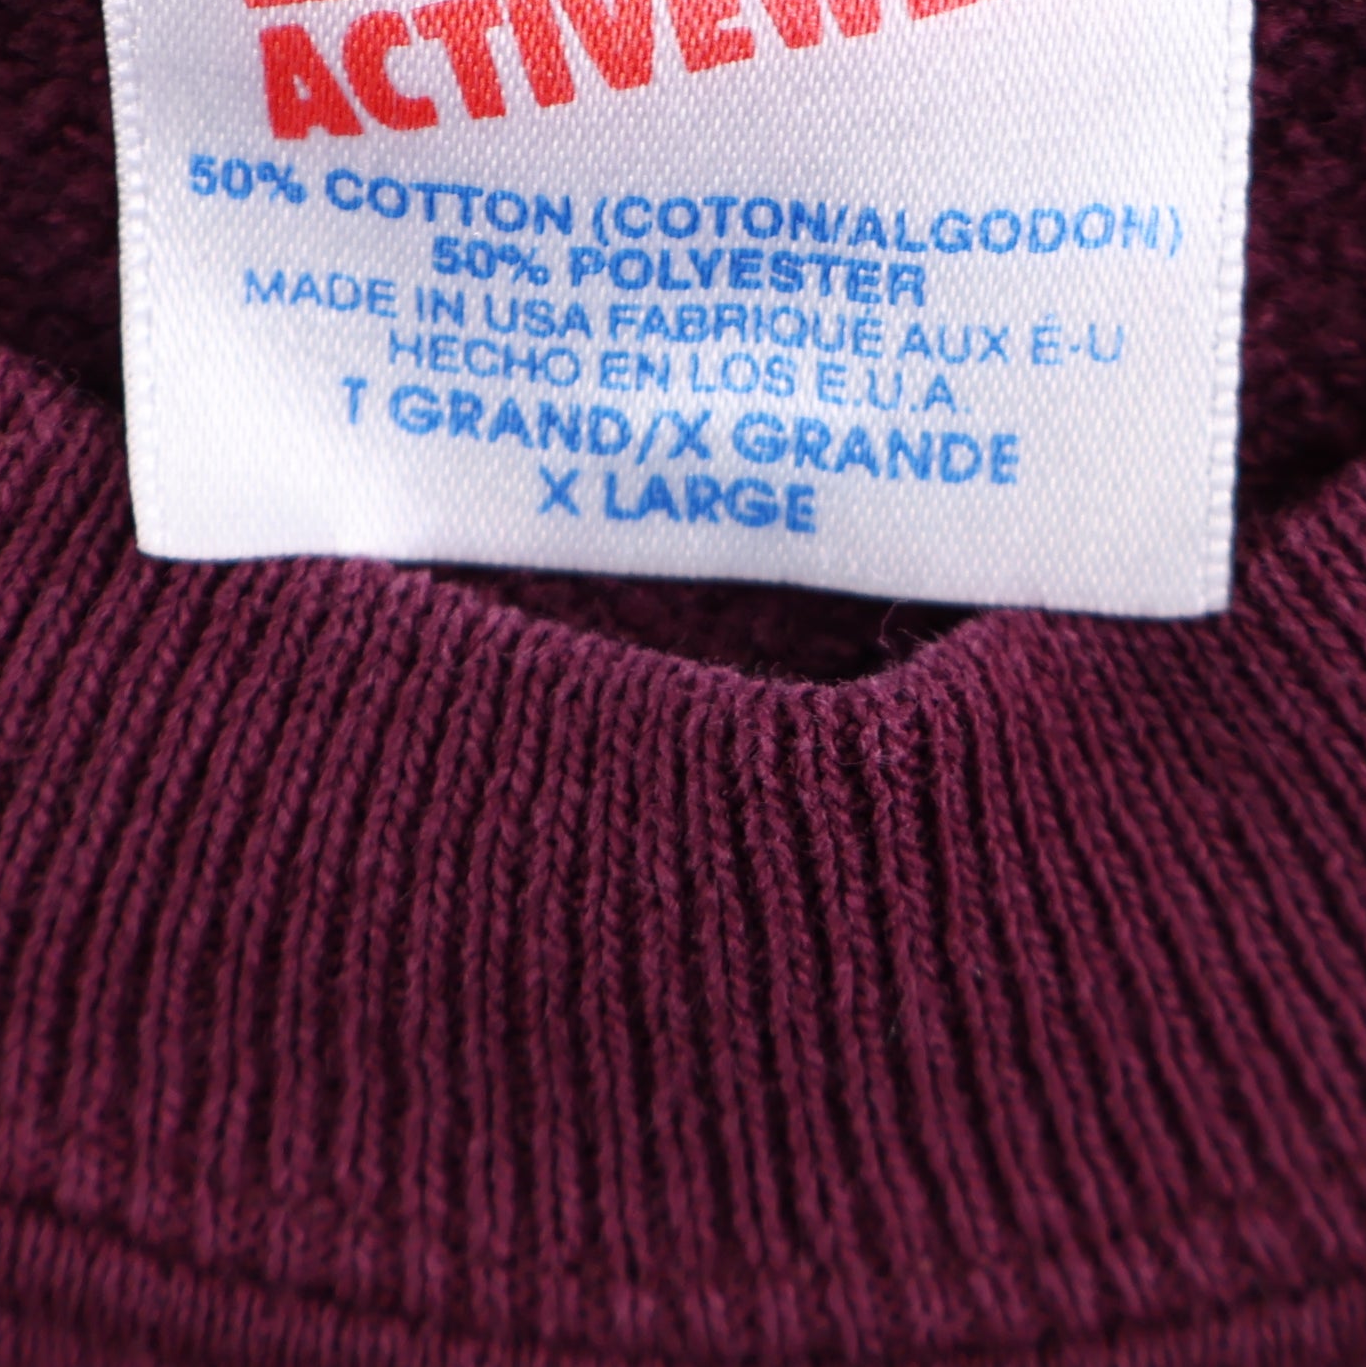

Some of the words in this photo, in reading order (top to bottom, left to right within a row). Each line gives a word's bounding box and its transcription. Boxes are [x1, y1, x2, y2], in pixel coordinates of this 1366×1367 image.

[188, 154, 308, 205] 50%
[325, 168, 573, 233] COTTON
[433, 236, 550, 286] 50%
[569, 246, 926, 308] POLYESTER
[243, 268, 397, 319] MADE
[414, 286, 465, 327] IN
[484, 292, 592, 339] USA
[896, 322, 1010, 365] AUX
[389, 329, 581, 387] HECHO
[600, 348, 671, 393] EN
[690, 352, 797, 397] LOS
[342, 376, 367, 425] T
[388, 384, 712, 465] GRAND/X
[732, 412, 1021, 485] GRANDE
[538, 465, 579, 516] X
[604, 472, 817, 534] LARGE
